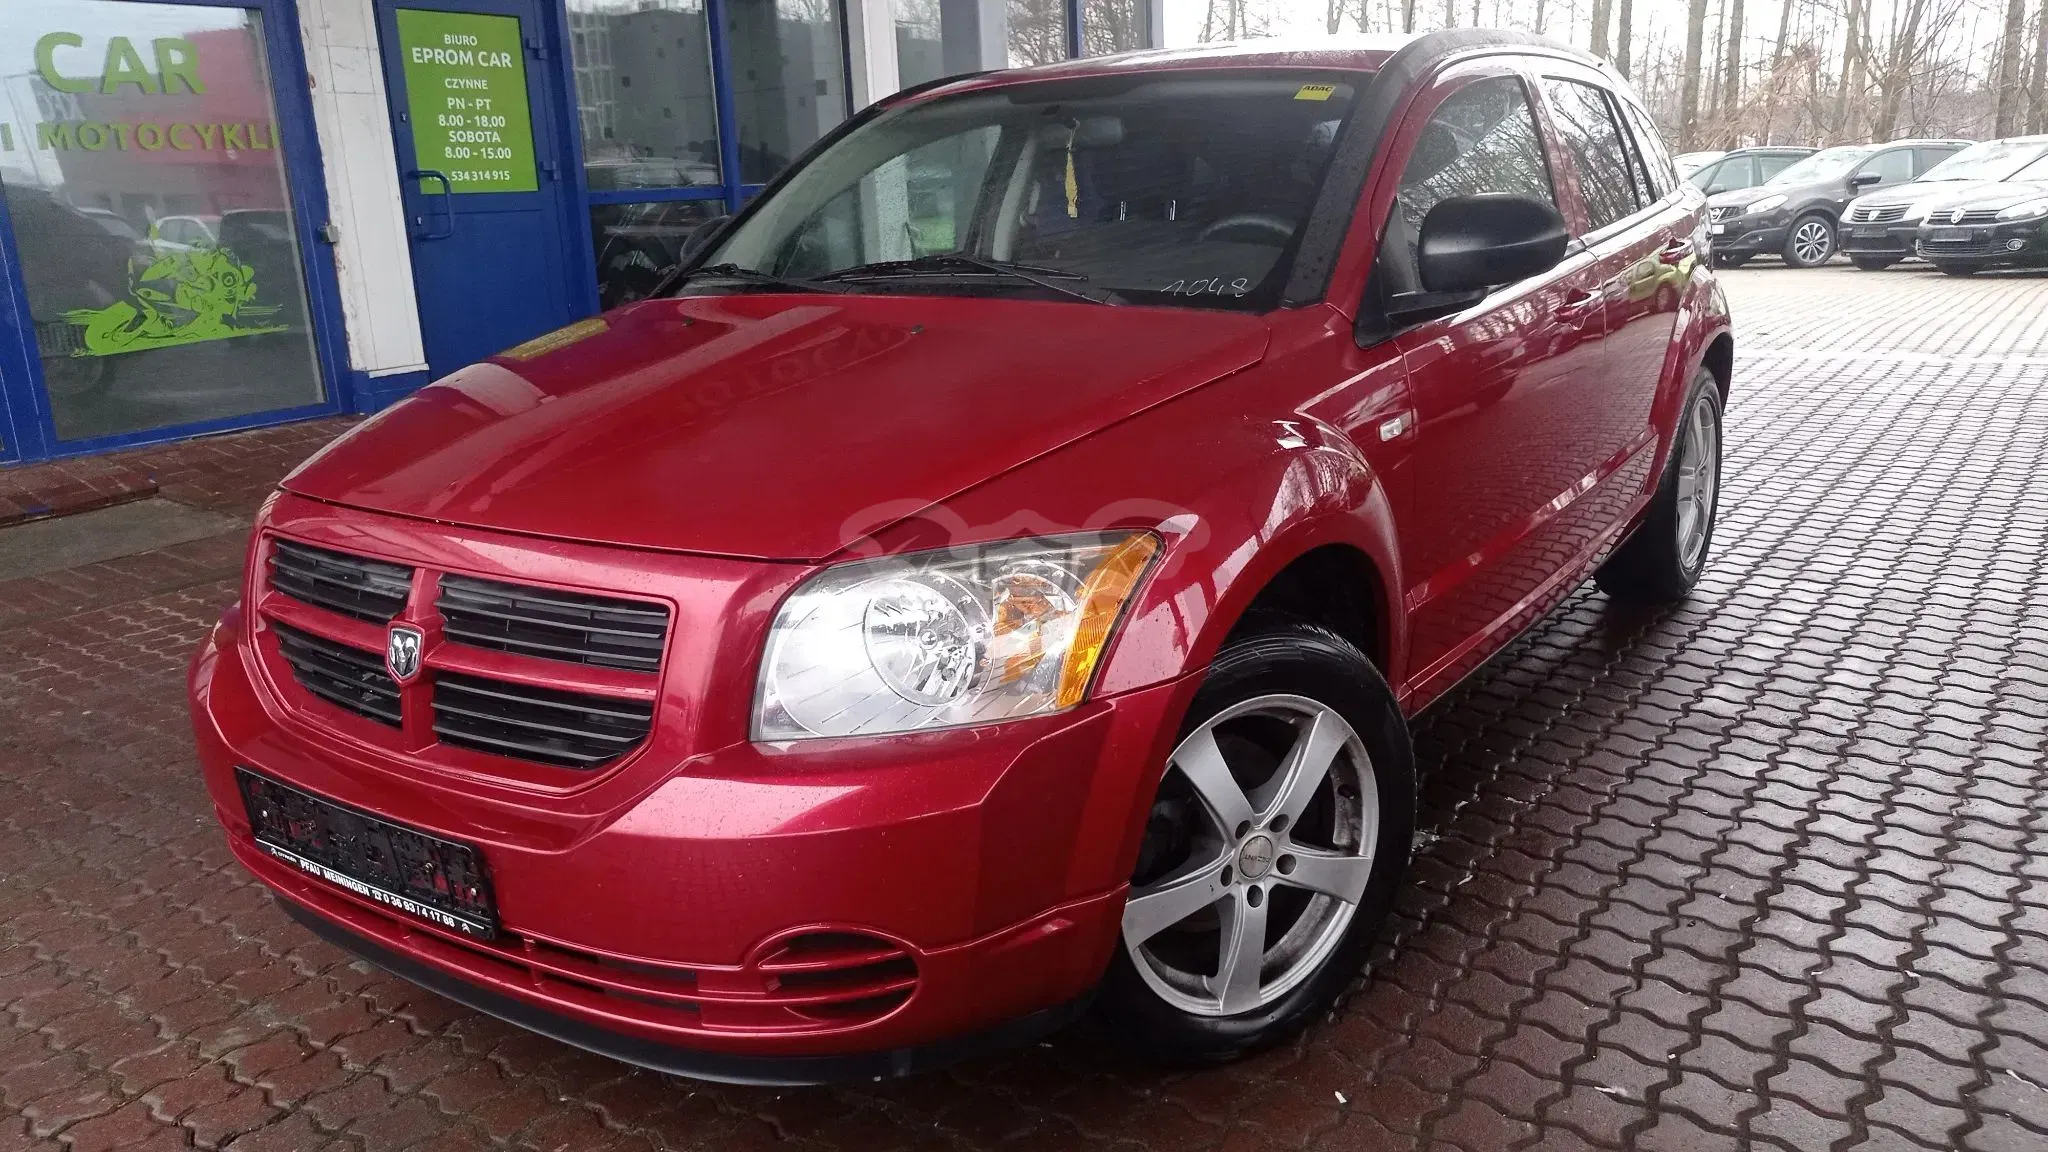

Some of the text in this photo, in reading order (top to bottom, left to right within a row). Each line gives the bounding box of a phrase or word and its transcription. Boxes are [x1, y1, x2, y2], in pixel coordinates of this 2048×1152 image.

[444, 34, 478, 46] BIURO
[34, 31, 206, 94] CAR
[412, 47, 512, 68] EPROM CAR
[445, 78, 489, 90] CZYNNE
[447, 97, 465, 110] PN
[475, 99, 491, 110] PT
[438, 114, 464, 127] 8.00
[449, 131, 501, 143] SOBOTA
[445, 147, 470, 159] 8.00
[480, 147, 511, 159] 15.00
[451, 171, 470, 181] 534
[472, 170, 490, 181] 314
[492, 170, 511, 181] 915
[300, 860, 320, 876] PFAU
[323, 869, 370, 897] MEININGEN
